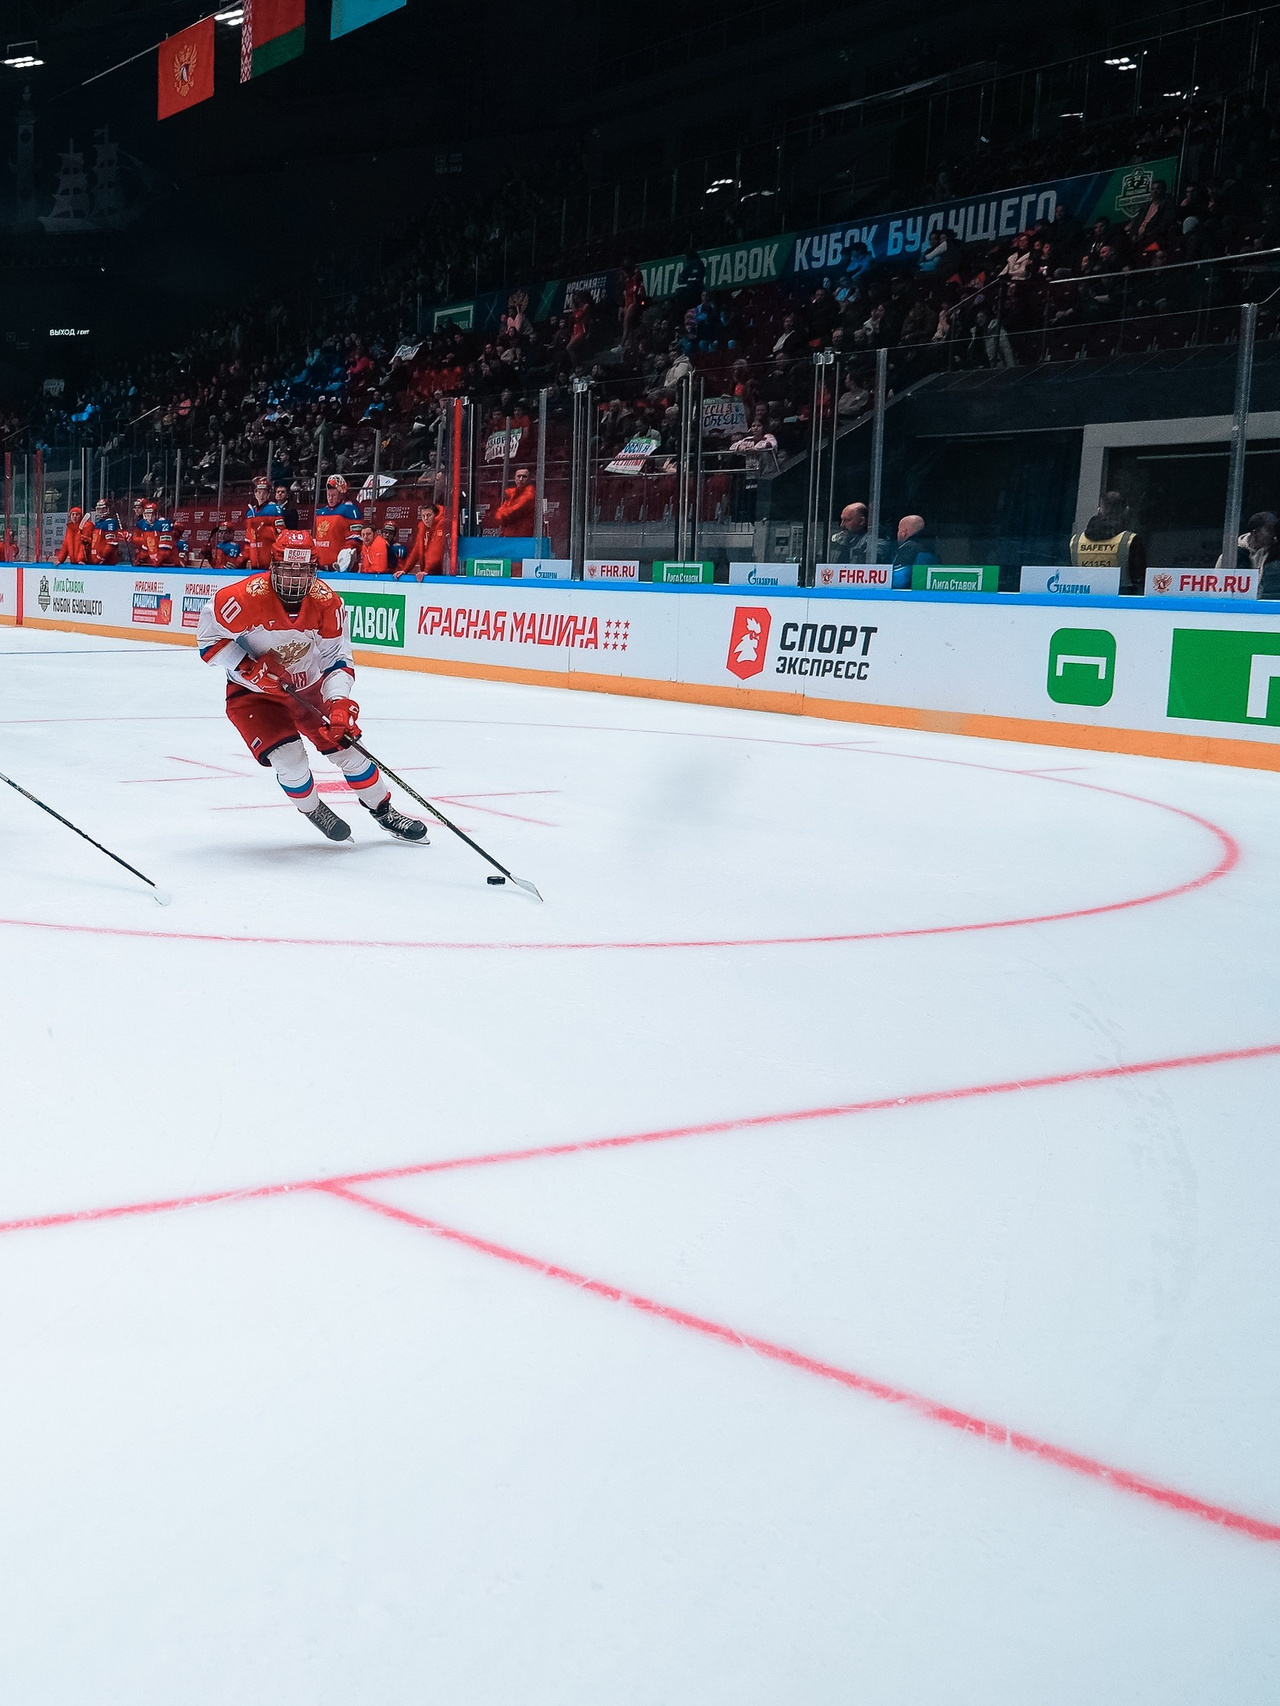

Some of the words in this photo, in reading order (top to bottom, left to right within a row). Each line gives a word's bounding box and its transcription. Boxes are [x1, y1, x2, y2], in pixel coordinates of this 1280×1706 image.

[701, 243, 780, 288] ТАВОК
[1080, 544, 1116, 552] SAFETY
[600, 565, 635, 578] FHR.RU
[838, 569, 888, 584] FHR.RU
[1179, 575, 1251, 594] FHR.RU
[220, 596, 243, 625] 10
[344, 604, 400, 642] ТАВОК
[417, 606, 507, 643] КРАСНАЯ
[509, 612, 600, 650] МАШИНА
[779, 622, 879, 656] СПОРТ
[775, 656, 870, 681] ЭКСПРЕСС
